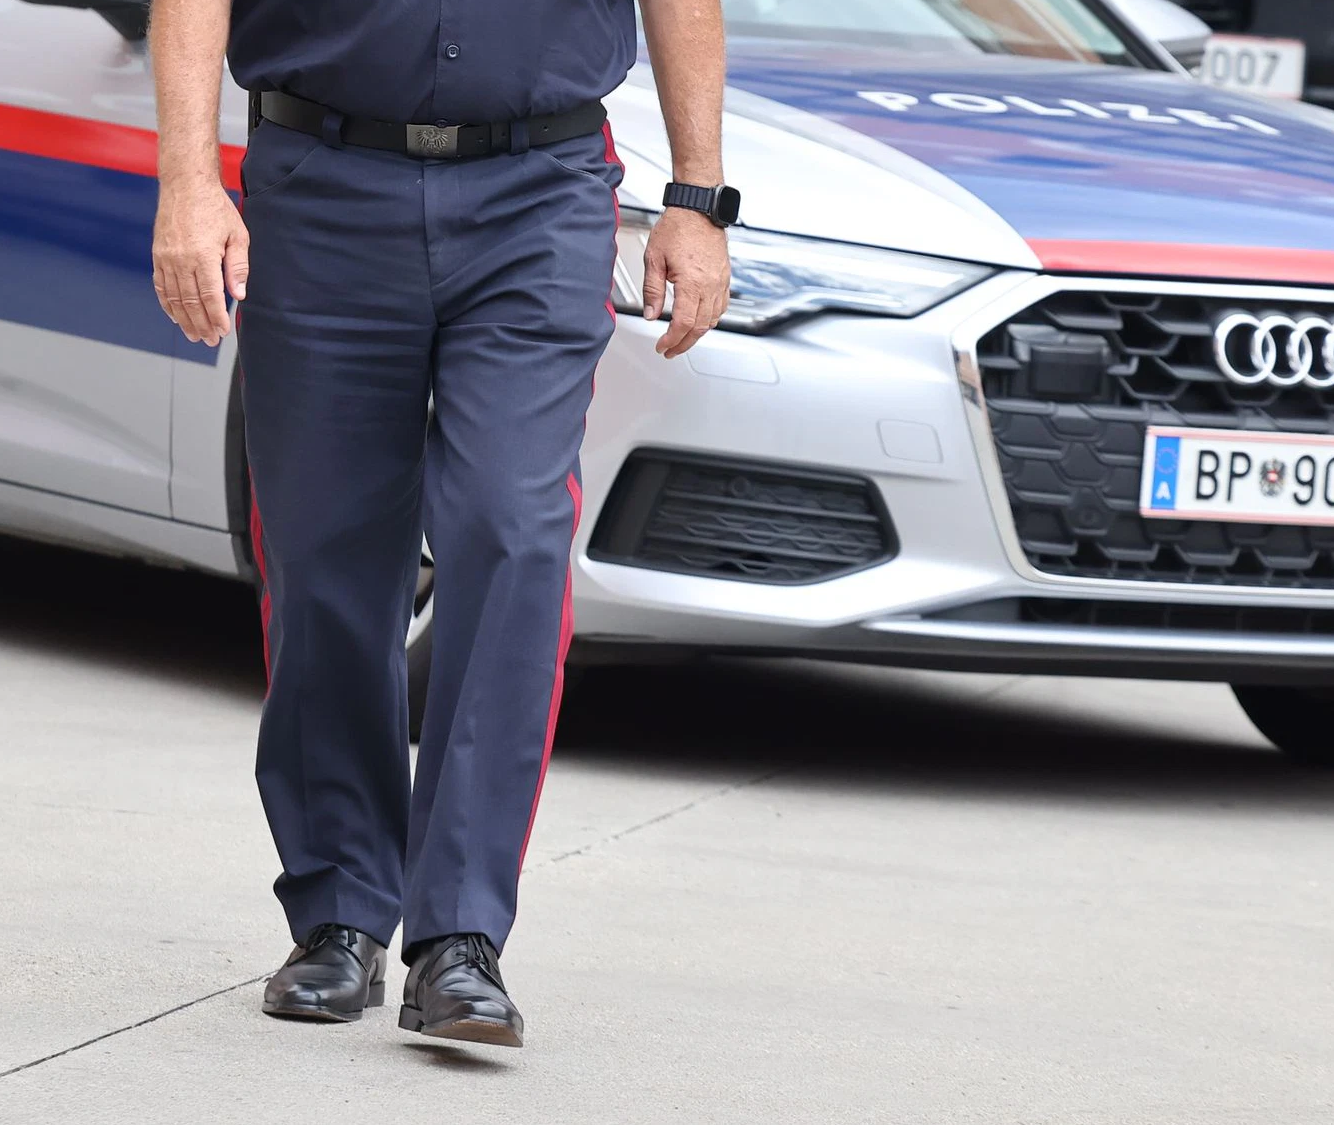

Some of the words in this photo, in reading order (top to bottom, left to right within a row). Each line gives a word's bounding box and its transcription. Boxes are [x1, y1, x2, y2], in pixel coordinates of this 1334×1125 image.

[856, 90, 1282, 136] POLIZEI
[1156, 481, 1172, 501] A
[1195, 450, 1252, 503] BP
